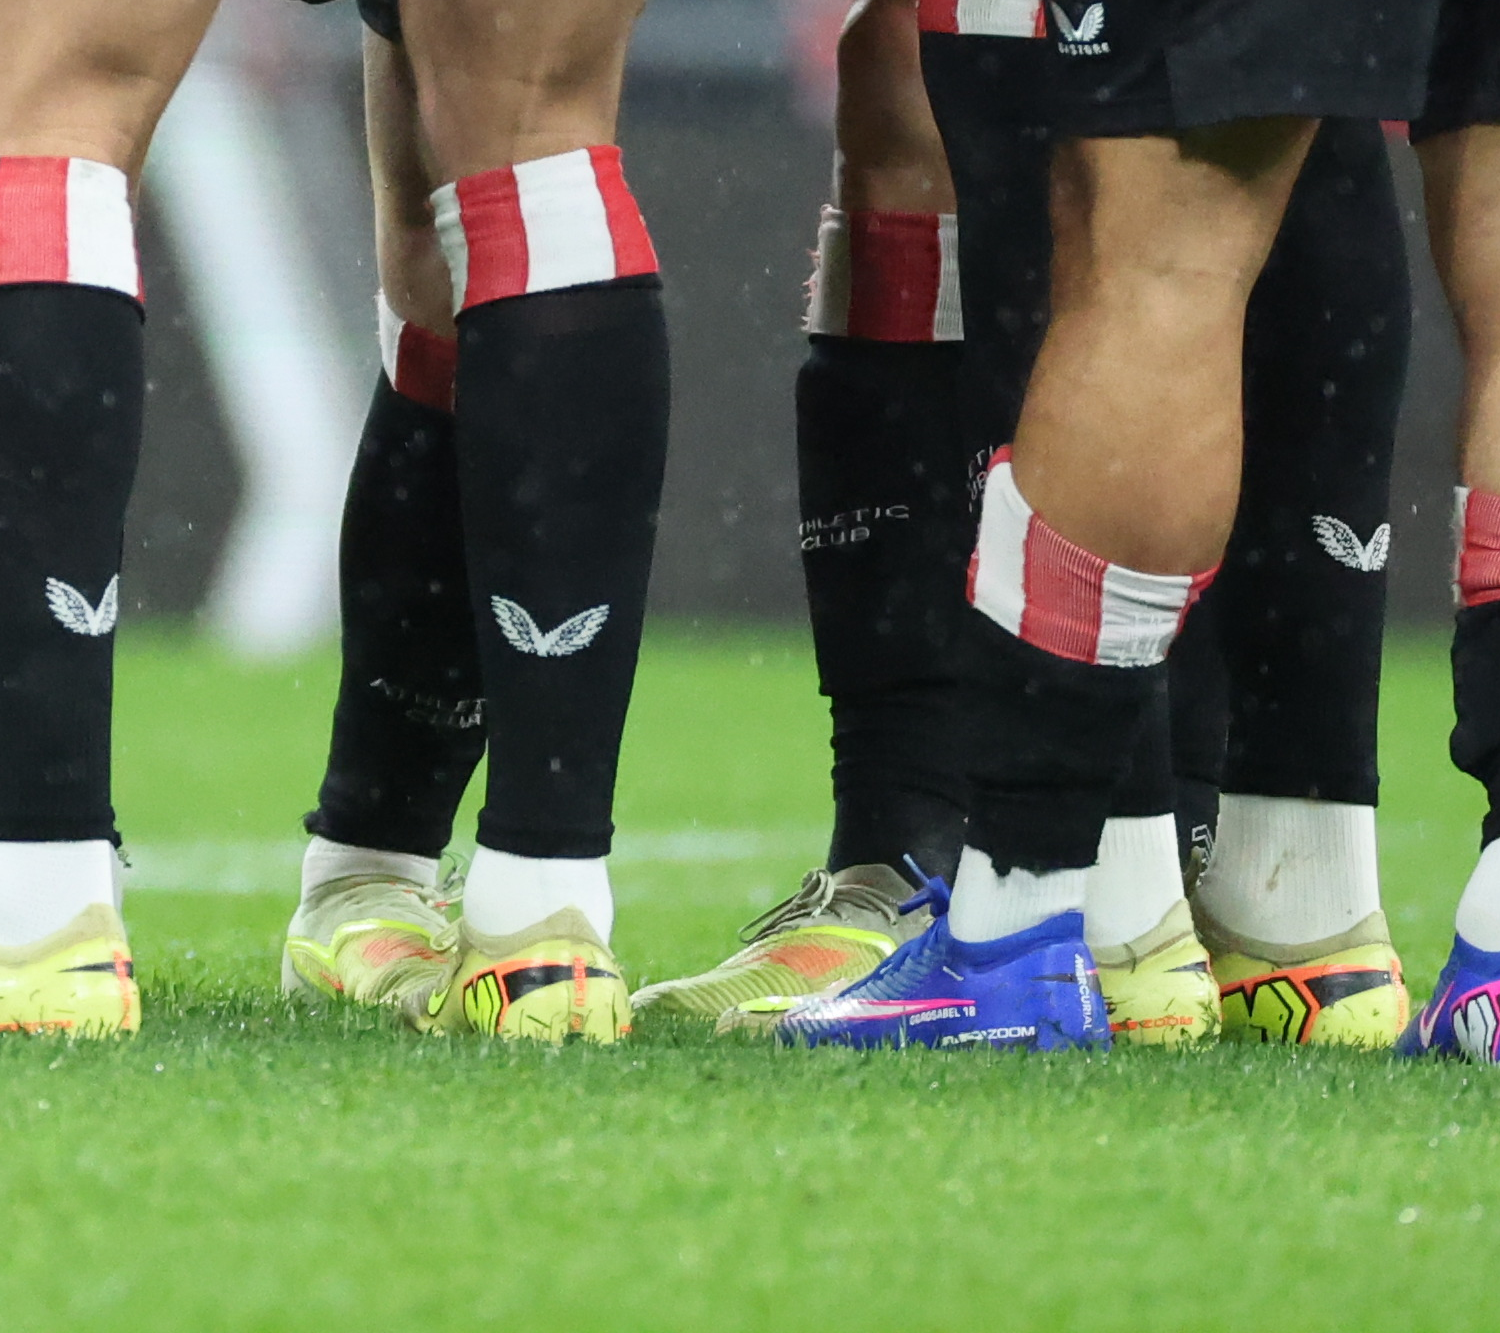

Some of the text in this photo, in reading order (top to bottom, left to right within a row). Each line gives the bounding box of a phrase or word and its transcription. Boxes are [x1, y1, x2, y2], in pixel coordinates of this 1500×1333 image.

[800, 525, 870, 550] CLUB
[1074, 952, 1093, 1032] MERCURIAL
[987, 1025, 1036, 1040] ZOOM
